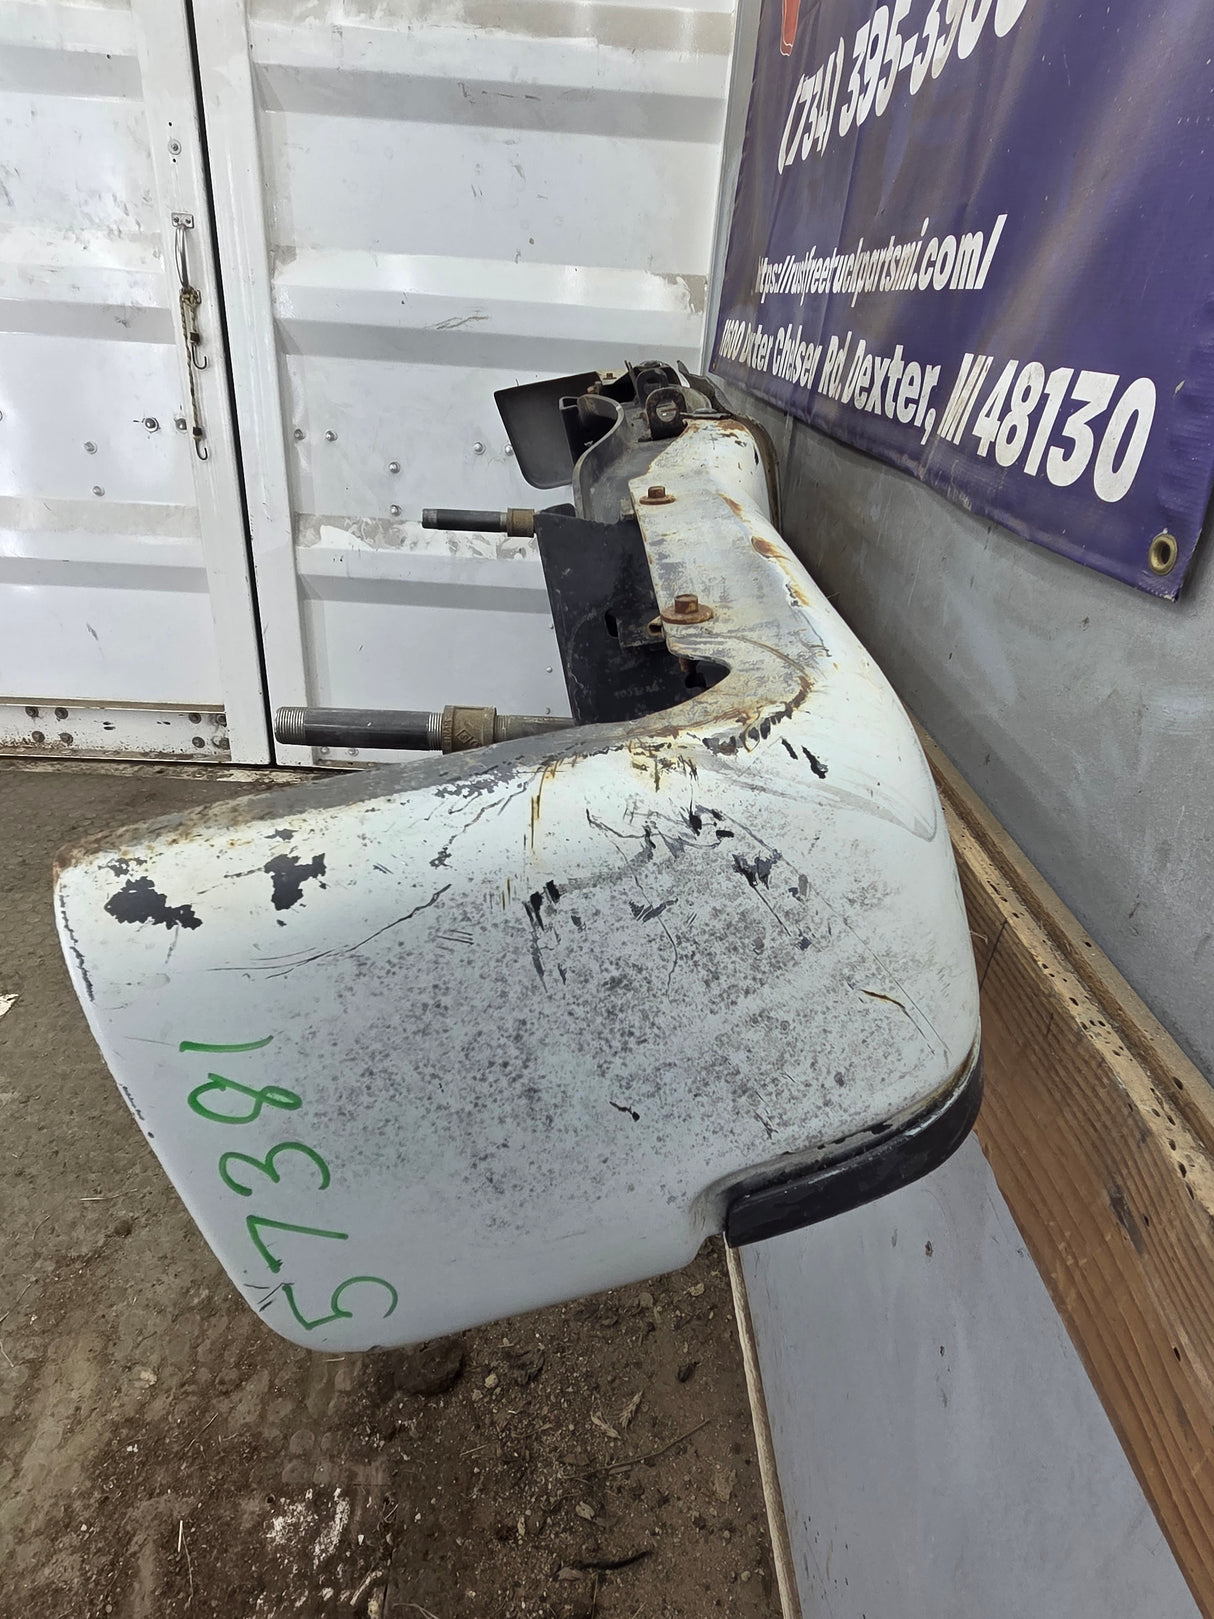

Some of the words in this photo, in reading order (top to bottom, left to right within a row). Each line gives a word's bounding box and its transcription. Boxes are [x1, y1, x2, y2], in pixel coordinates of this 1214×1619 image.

[778, 36, 845, 175] (734)
[839, 0, 1028, 137] 395-39
[754, 214, 1008, 308] tps://rustfreetruckpartsmi.com/
[738, 322, 774, 372] Dxter
[841, 338, 941, 445] Dexter,
[936, 352, 994, 445] MI
[971, 359, 1157, 503] 48130
